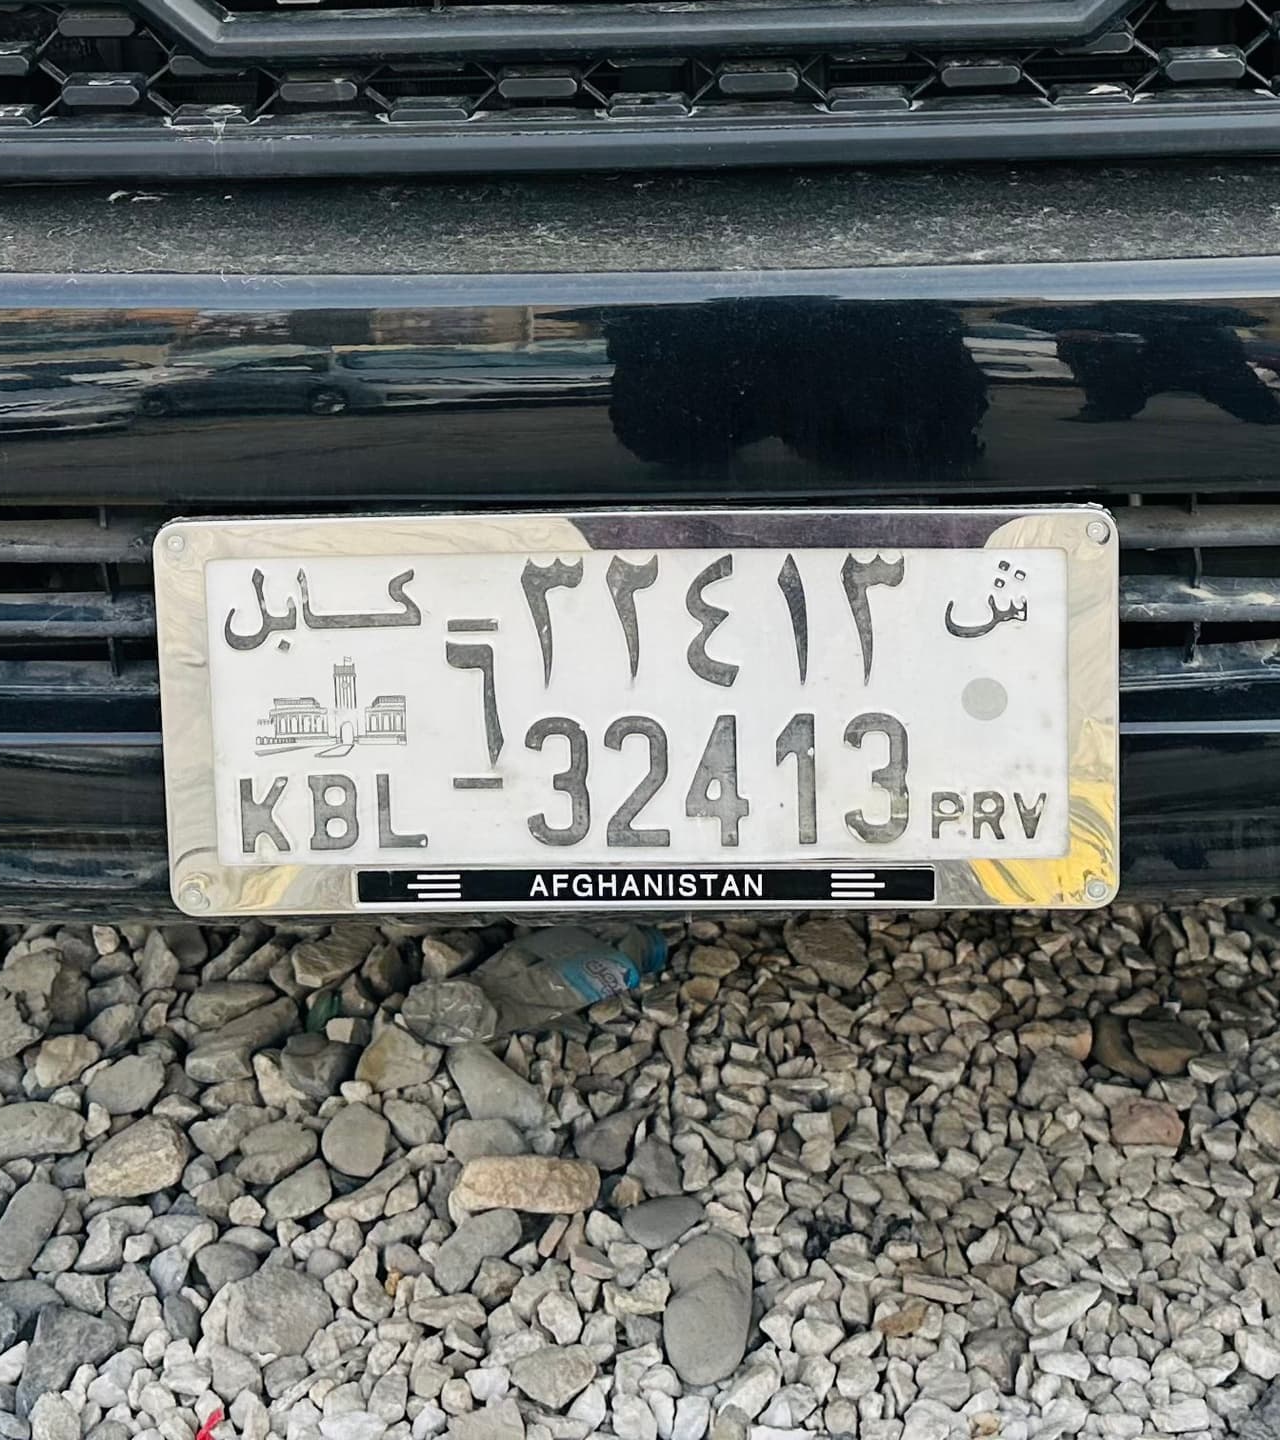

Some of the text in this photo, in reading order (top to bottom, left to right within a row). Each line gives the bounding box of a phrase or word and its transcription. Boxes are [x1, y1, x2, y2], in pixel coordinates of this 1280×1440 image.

[238, 711, 1048, 855] KBL 32413 PRV
[527, 871, 766, 900] AFGHANISTAN
